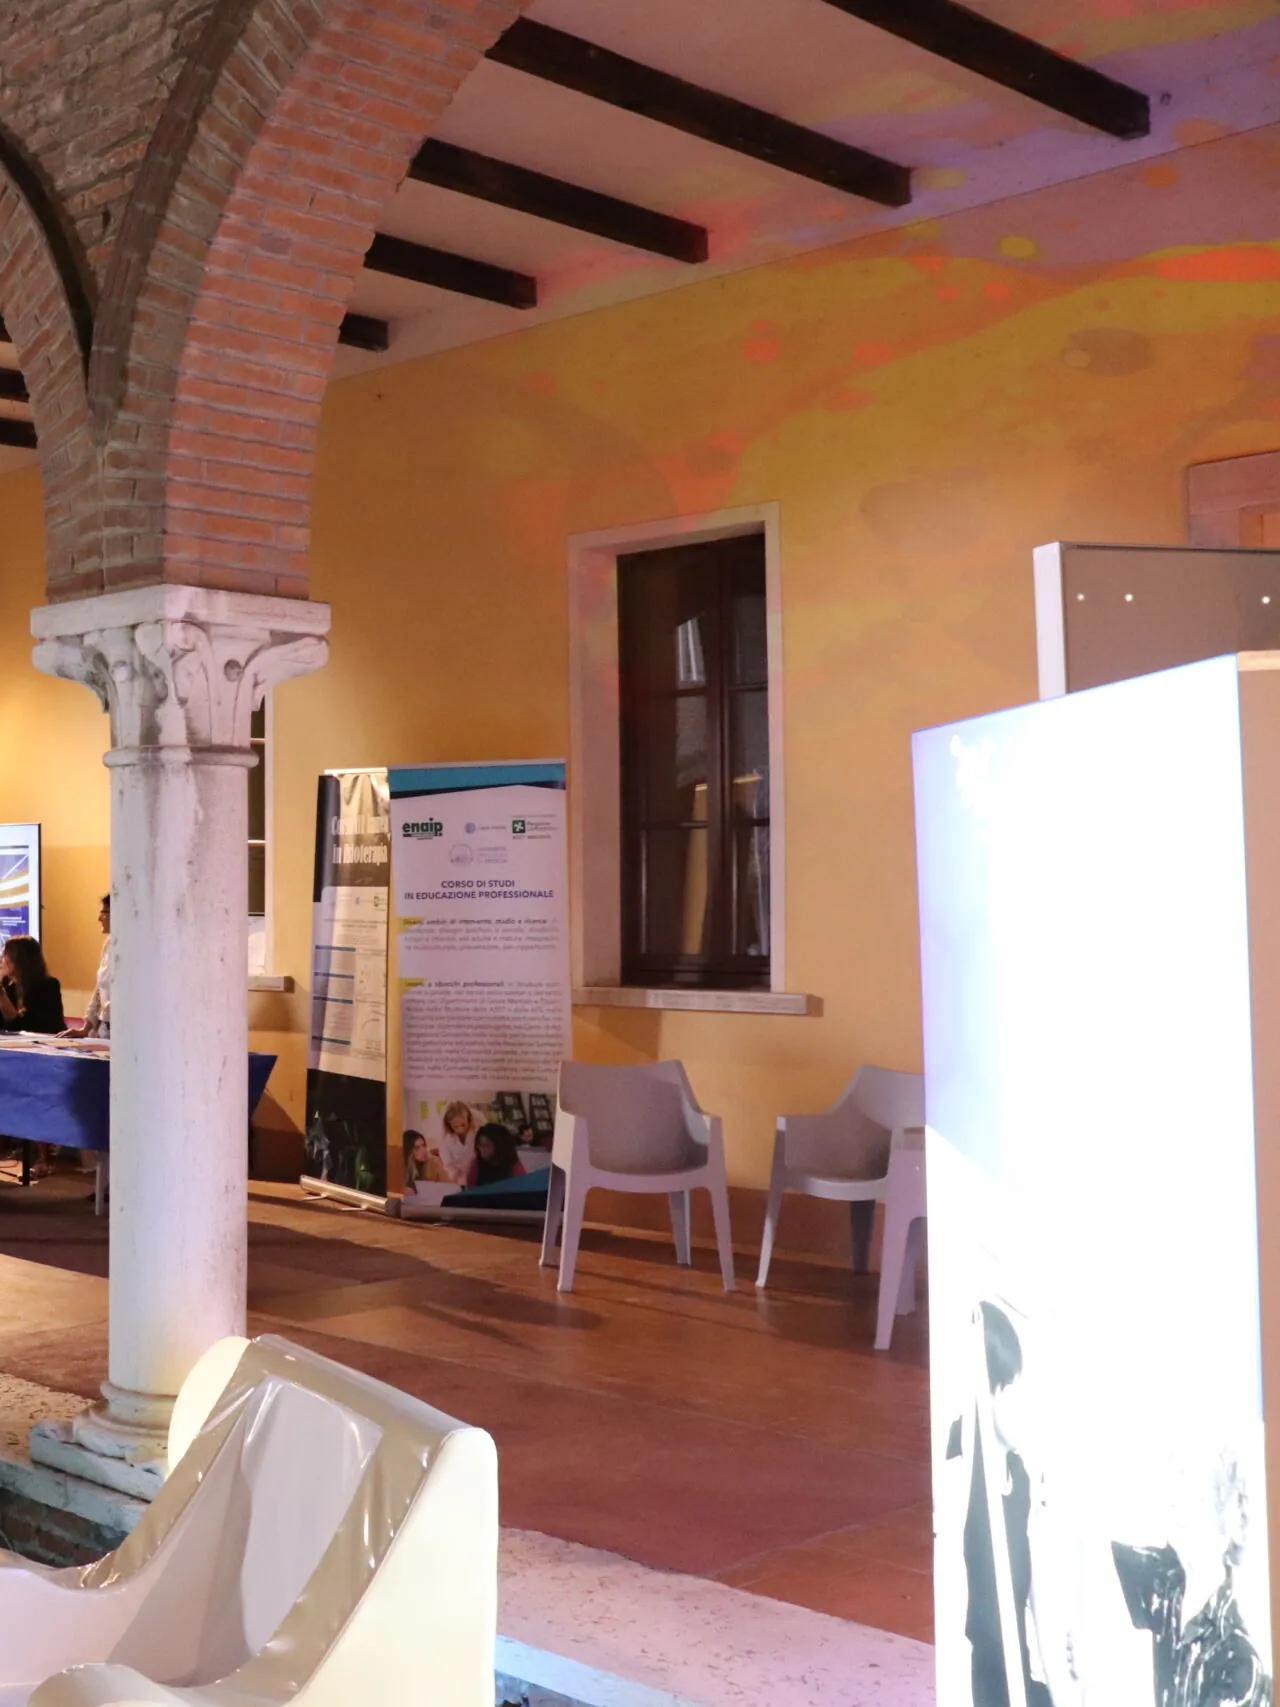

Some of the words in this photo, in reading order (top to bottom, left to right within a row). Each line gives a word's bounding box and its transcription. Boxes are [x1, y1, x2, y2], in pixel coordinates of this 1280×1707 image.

[402, 817, 443, 837] enaip
[441, 880, 474, 889] CORSO
[476, 880, 486, 888] DI
[488, 879, 515, 888] STUDI
[404, 892, 414, 900] IN
[416, 891, 476, 900] EDUCAZIONE
[479, 890, 554, 899] PROFESSIONALE
